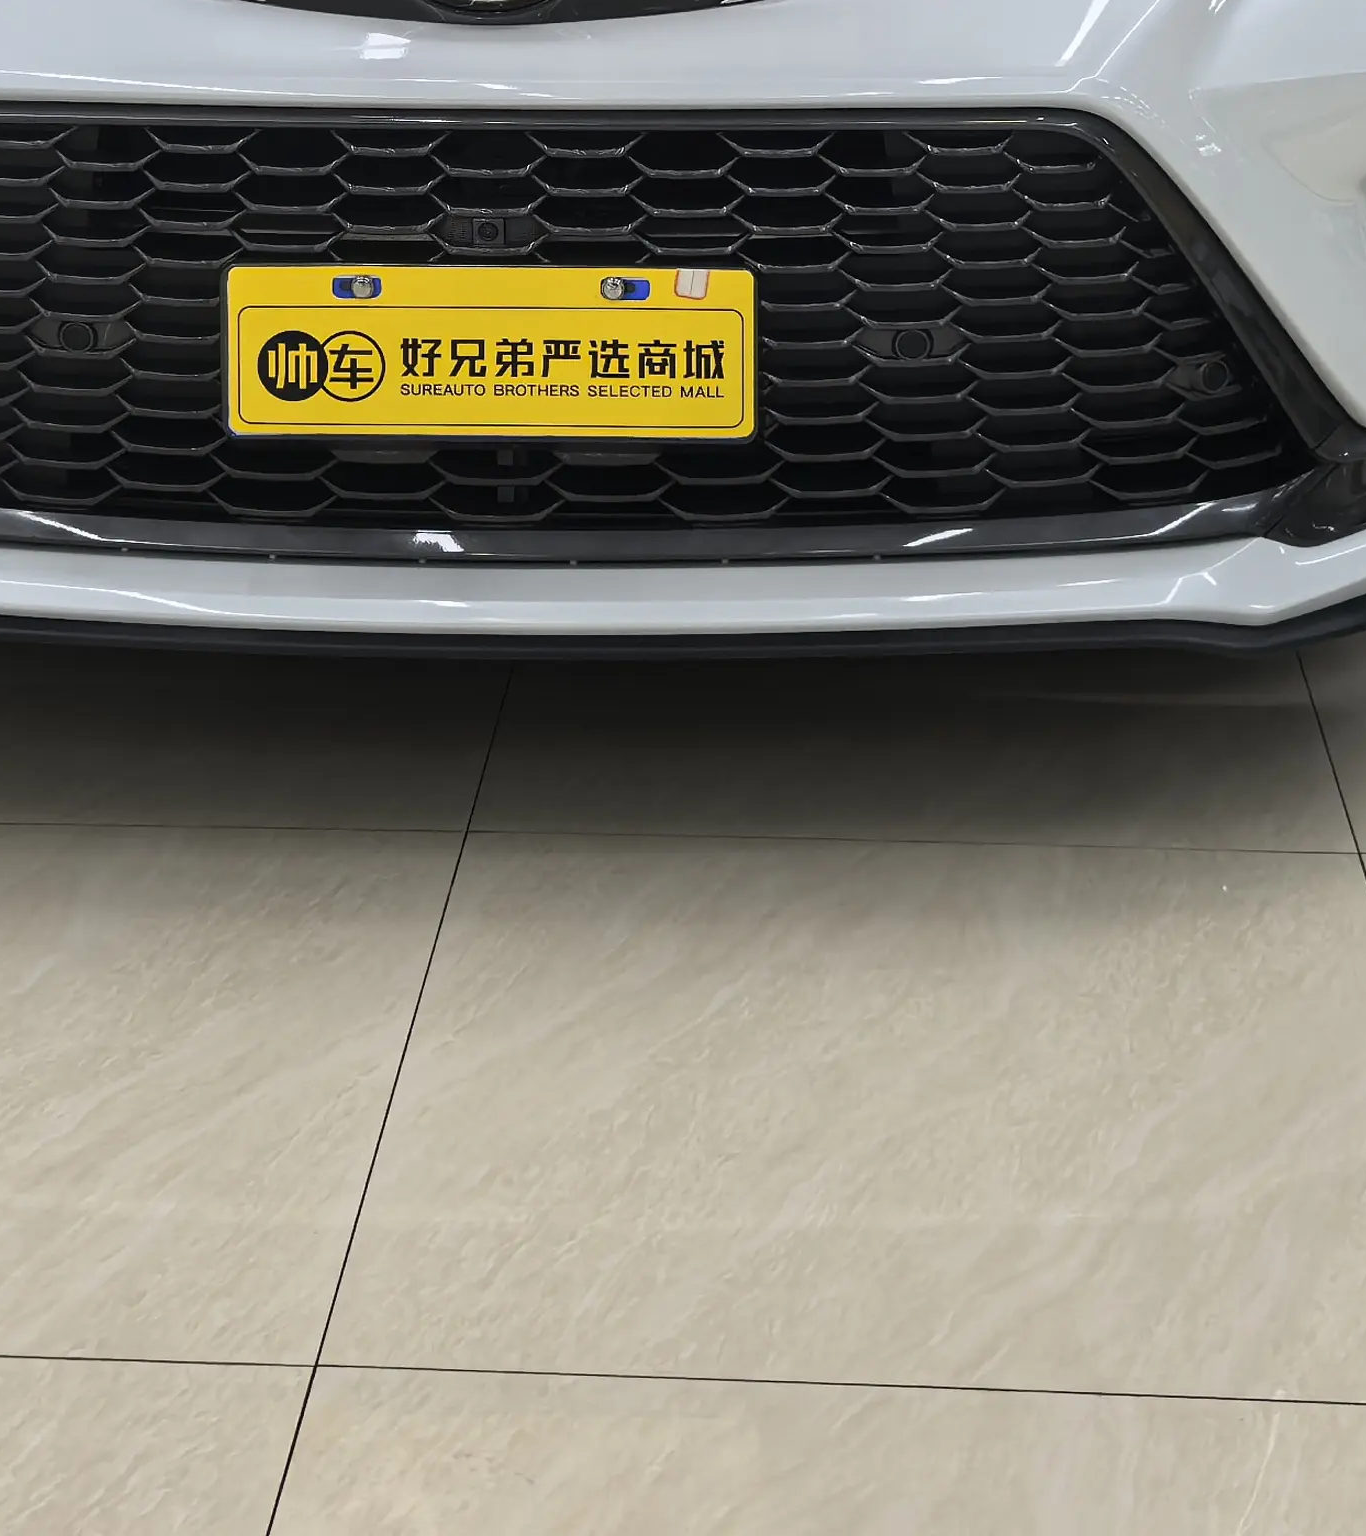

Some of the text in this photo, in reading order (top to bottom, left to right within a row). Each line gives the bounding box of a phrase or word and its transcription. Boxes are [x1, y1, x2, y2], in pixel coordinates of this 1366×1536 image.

[400, 337, 725, 381] 好兄弟严选商城
[400, 383, 725, 398] SUREAUTO BROTHERS SELECTED MALL
